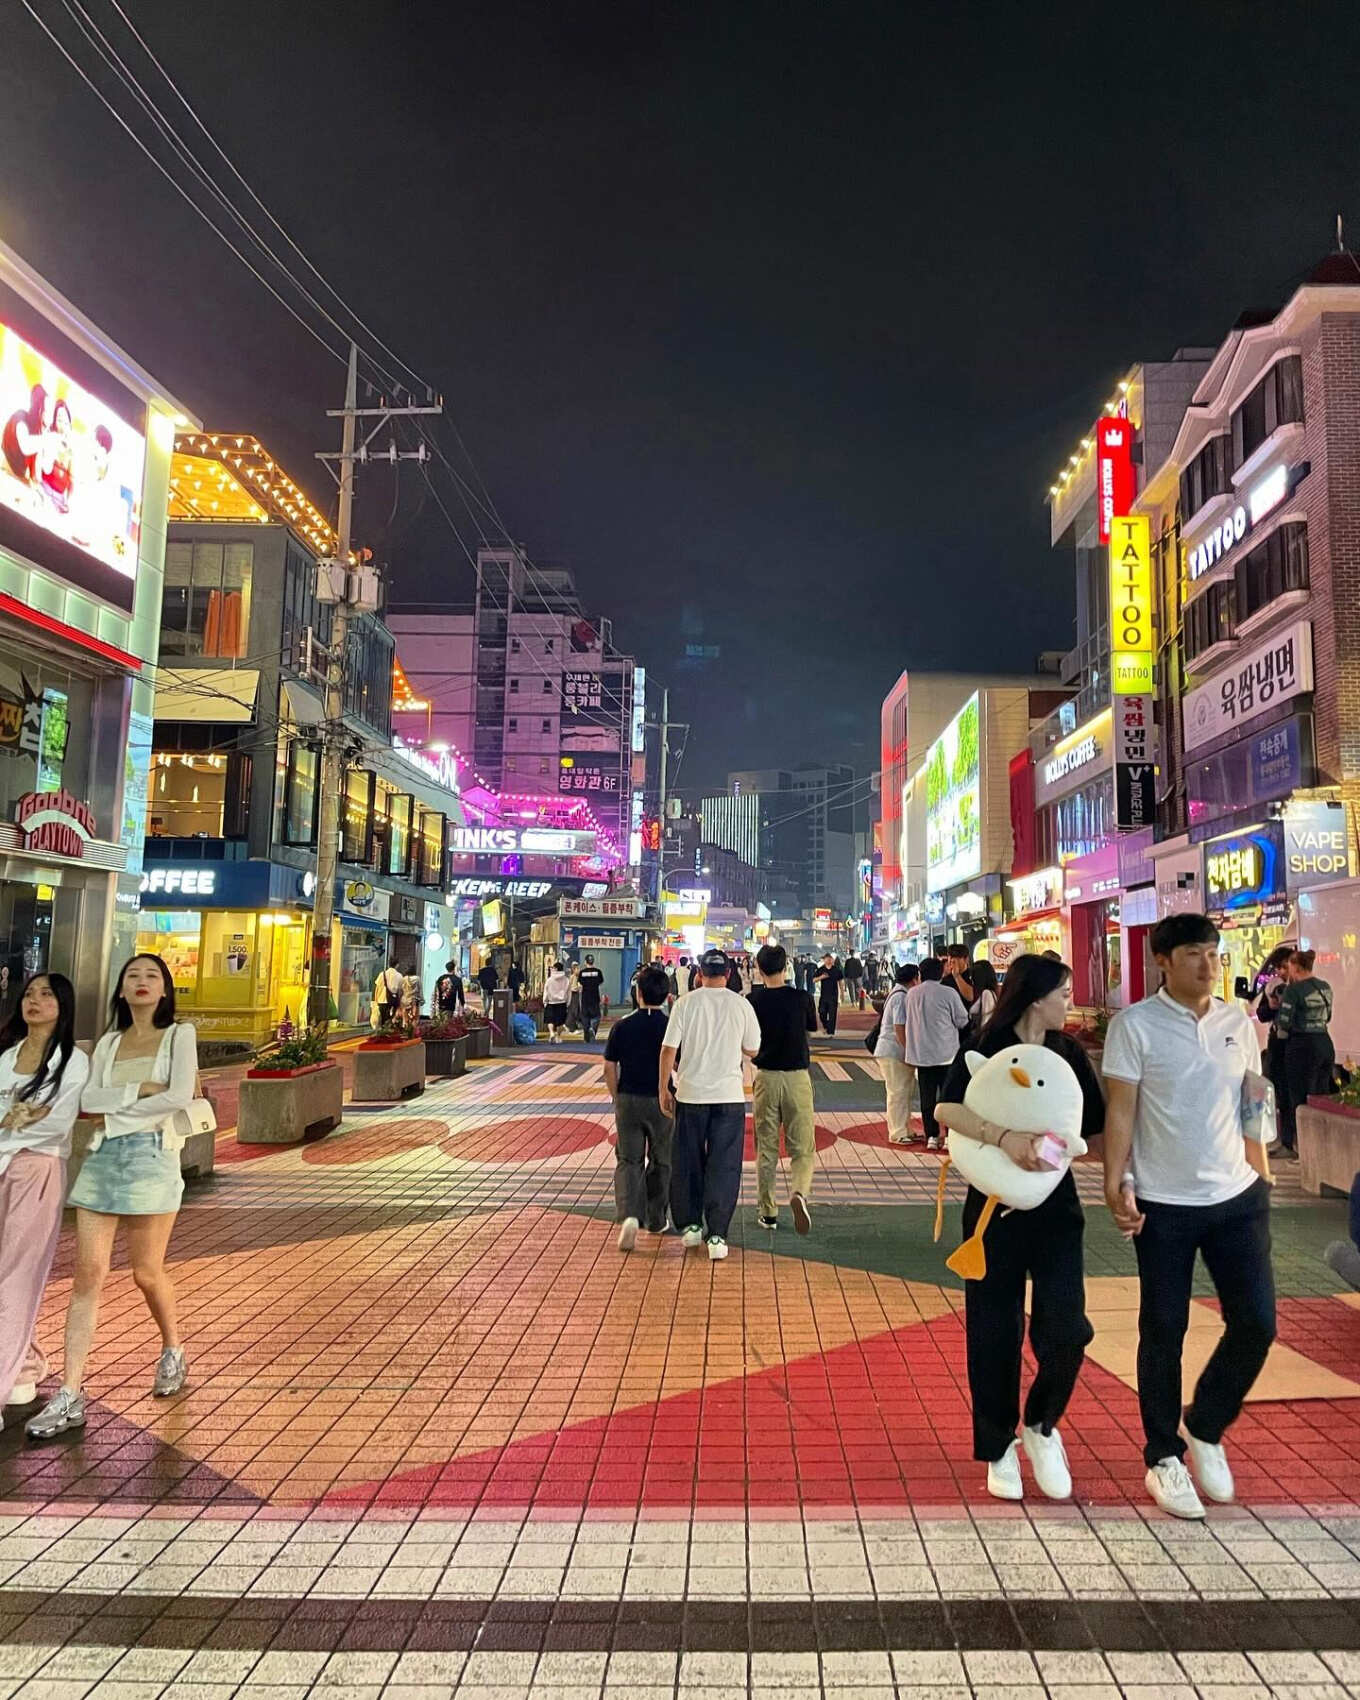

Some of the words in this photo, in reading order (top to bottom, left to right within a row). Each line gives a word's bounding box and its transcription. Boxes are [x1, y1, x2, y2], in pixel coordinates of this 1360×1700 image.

[1189, 506, 1246, 581] TATTOO
[1121, 521, 1141, 646] TATTOO
[1116, 667, 1149, 680] TATTOO
[1221, 638, 1295, 718] 육쌈냉면
[1123, 696, 1146, 761] 육쌈냉면
[1068, 735, 1096, 770] COFFEE
[560, 775, 602, 790] 영화관
[603, 776, 617, 790] 6F
[32, 821, 83, 858] PLAYTOWN
[1290, 831, 1345, 850] VAPE
[1207, 848, 1255, 894] 전자담배
[1290, 854, 1347, 873] SHOP
